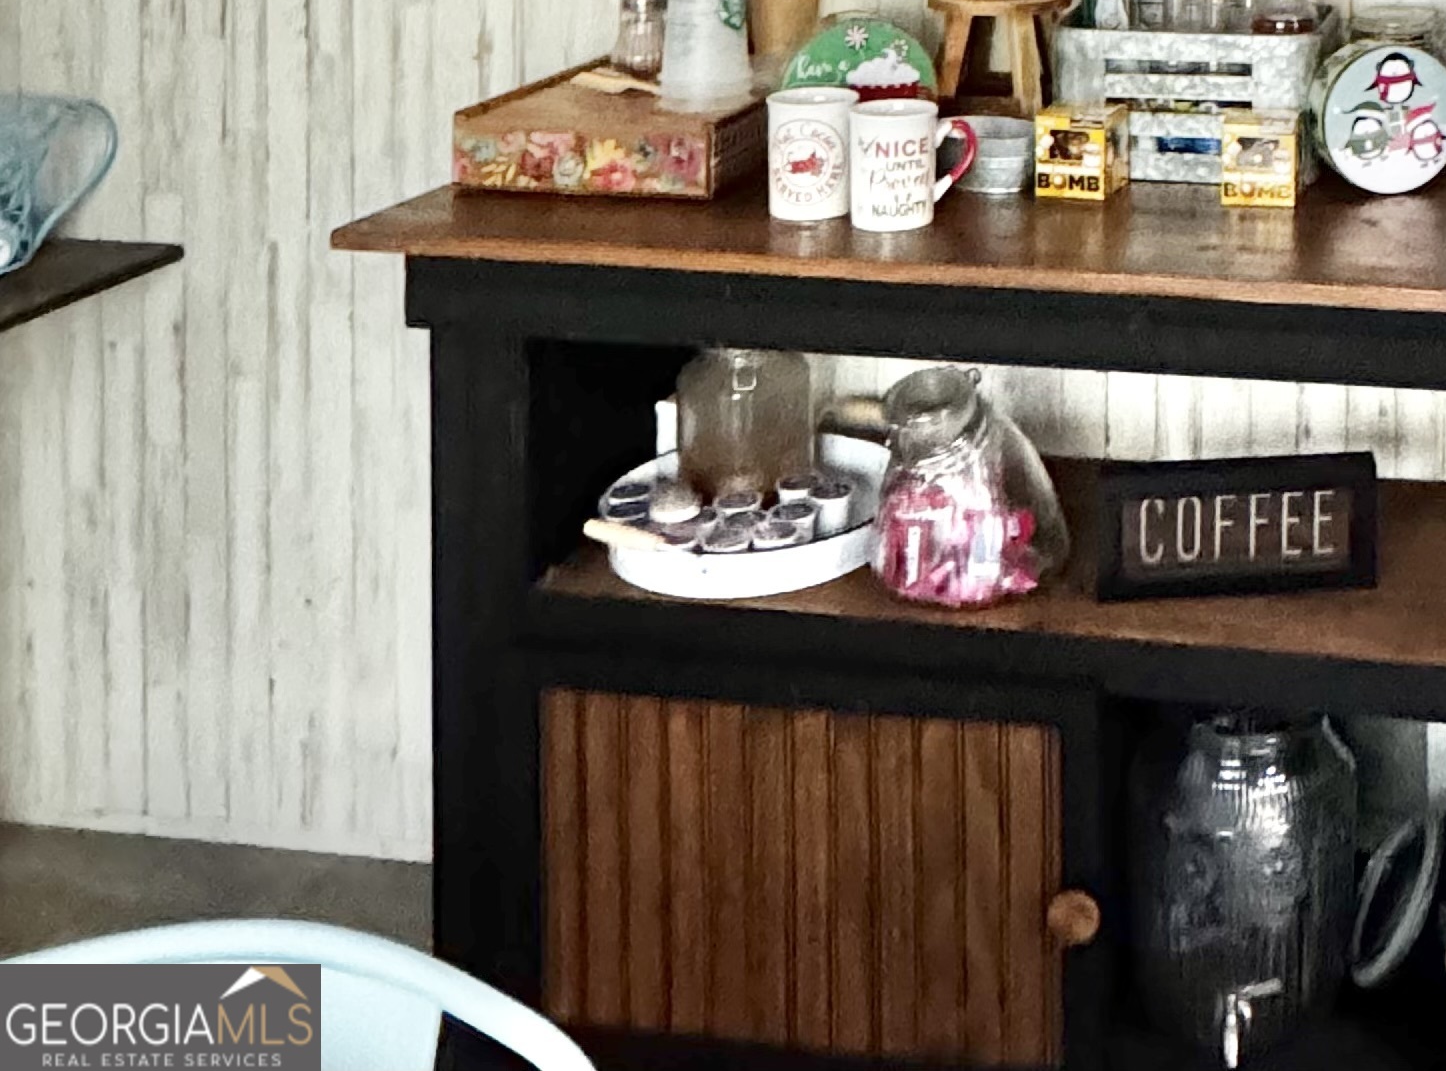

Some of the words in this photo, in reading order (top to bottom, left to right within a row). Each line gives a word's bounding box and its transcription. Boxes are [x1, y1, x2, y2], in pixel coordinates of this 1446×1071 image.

[875, 137, 929, 159] NICE
[886, 158, 925, 172] UNTIL
[1138, 489, 1338, 564] COFFEE
